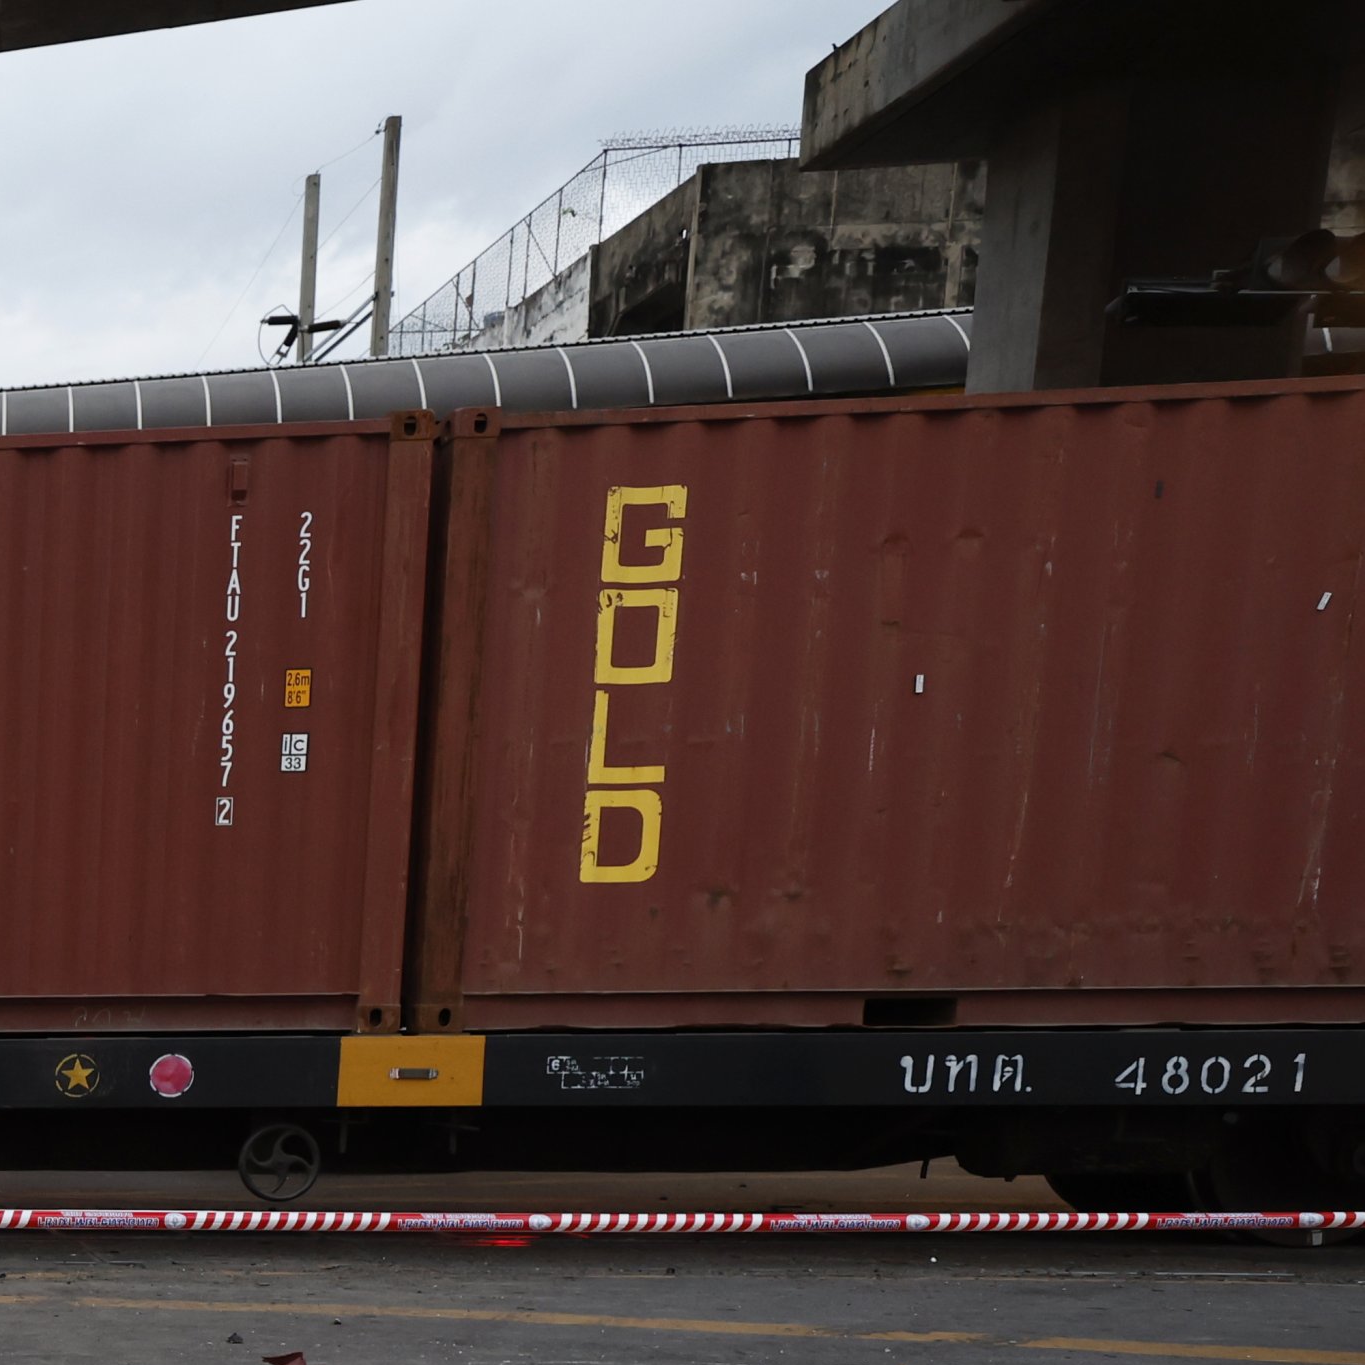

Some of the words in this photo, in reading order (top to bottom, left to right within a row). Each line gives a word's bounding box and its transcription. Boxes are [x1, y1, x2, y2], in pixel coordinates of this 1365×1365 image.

[226, 515, 243, 622] FTAU
[297, 511, 313, 618] 22G1
[219, 630, 238, 787] 219657
[287, 672, 310, 688] 2,6m
[579, 484, 688, 883] GOLD
[285, 757, 302, 770] 33
[1114, 1053, 1308, 1097] 48021
